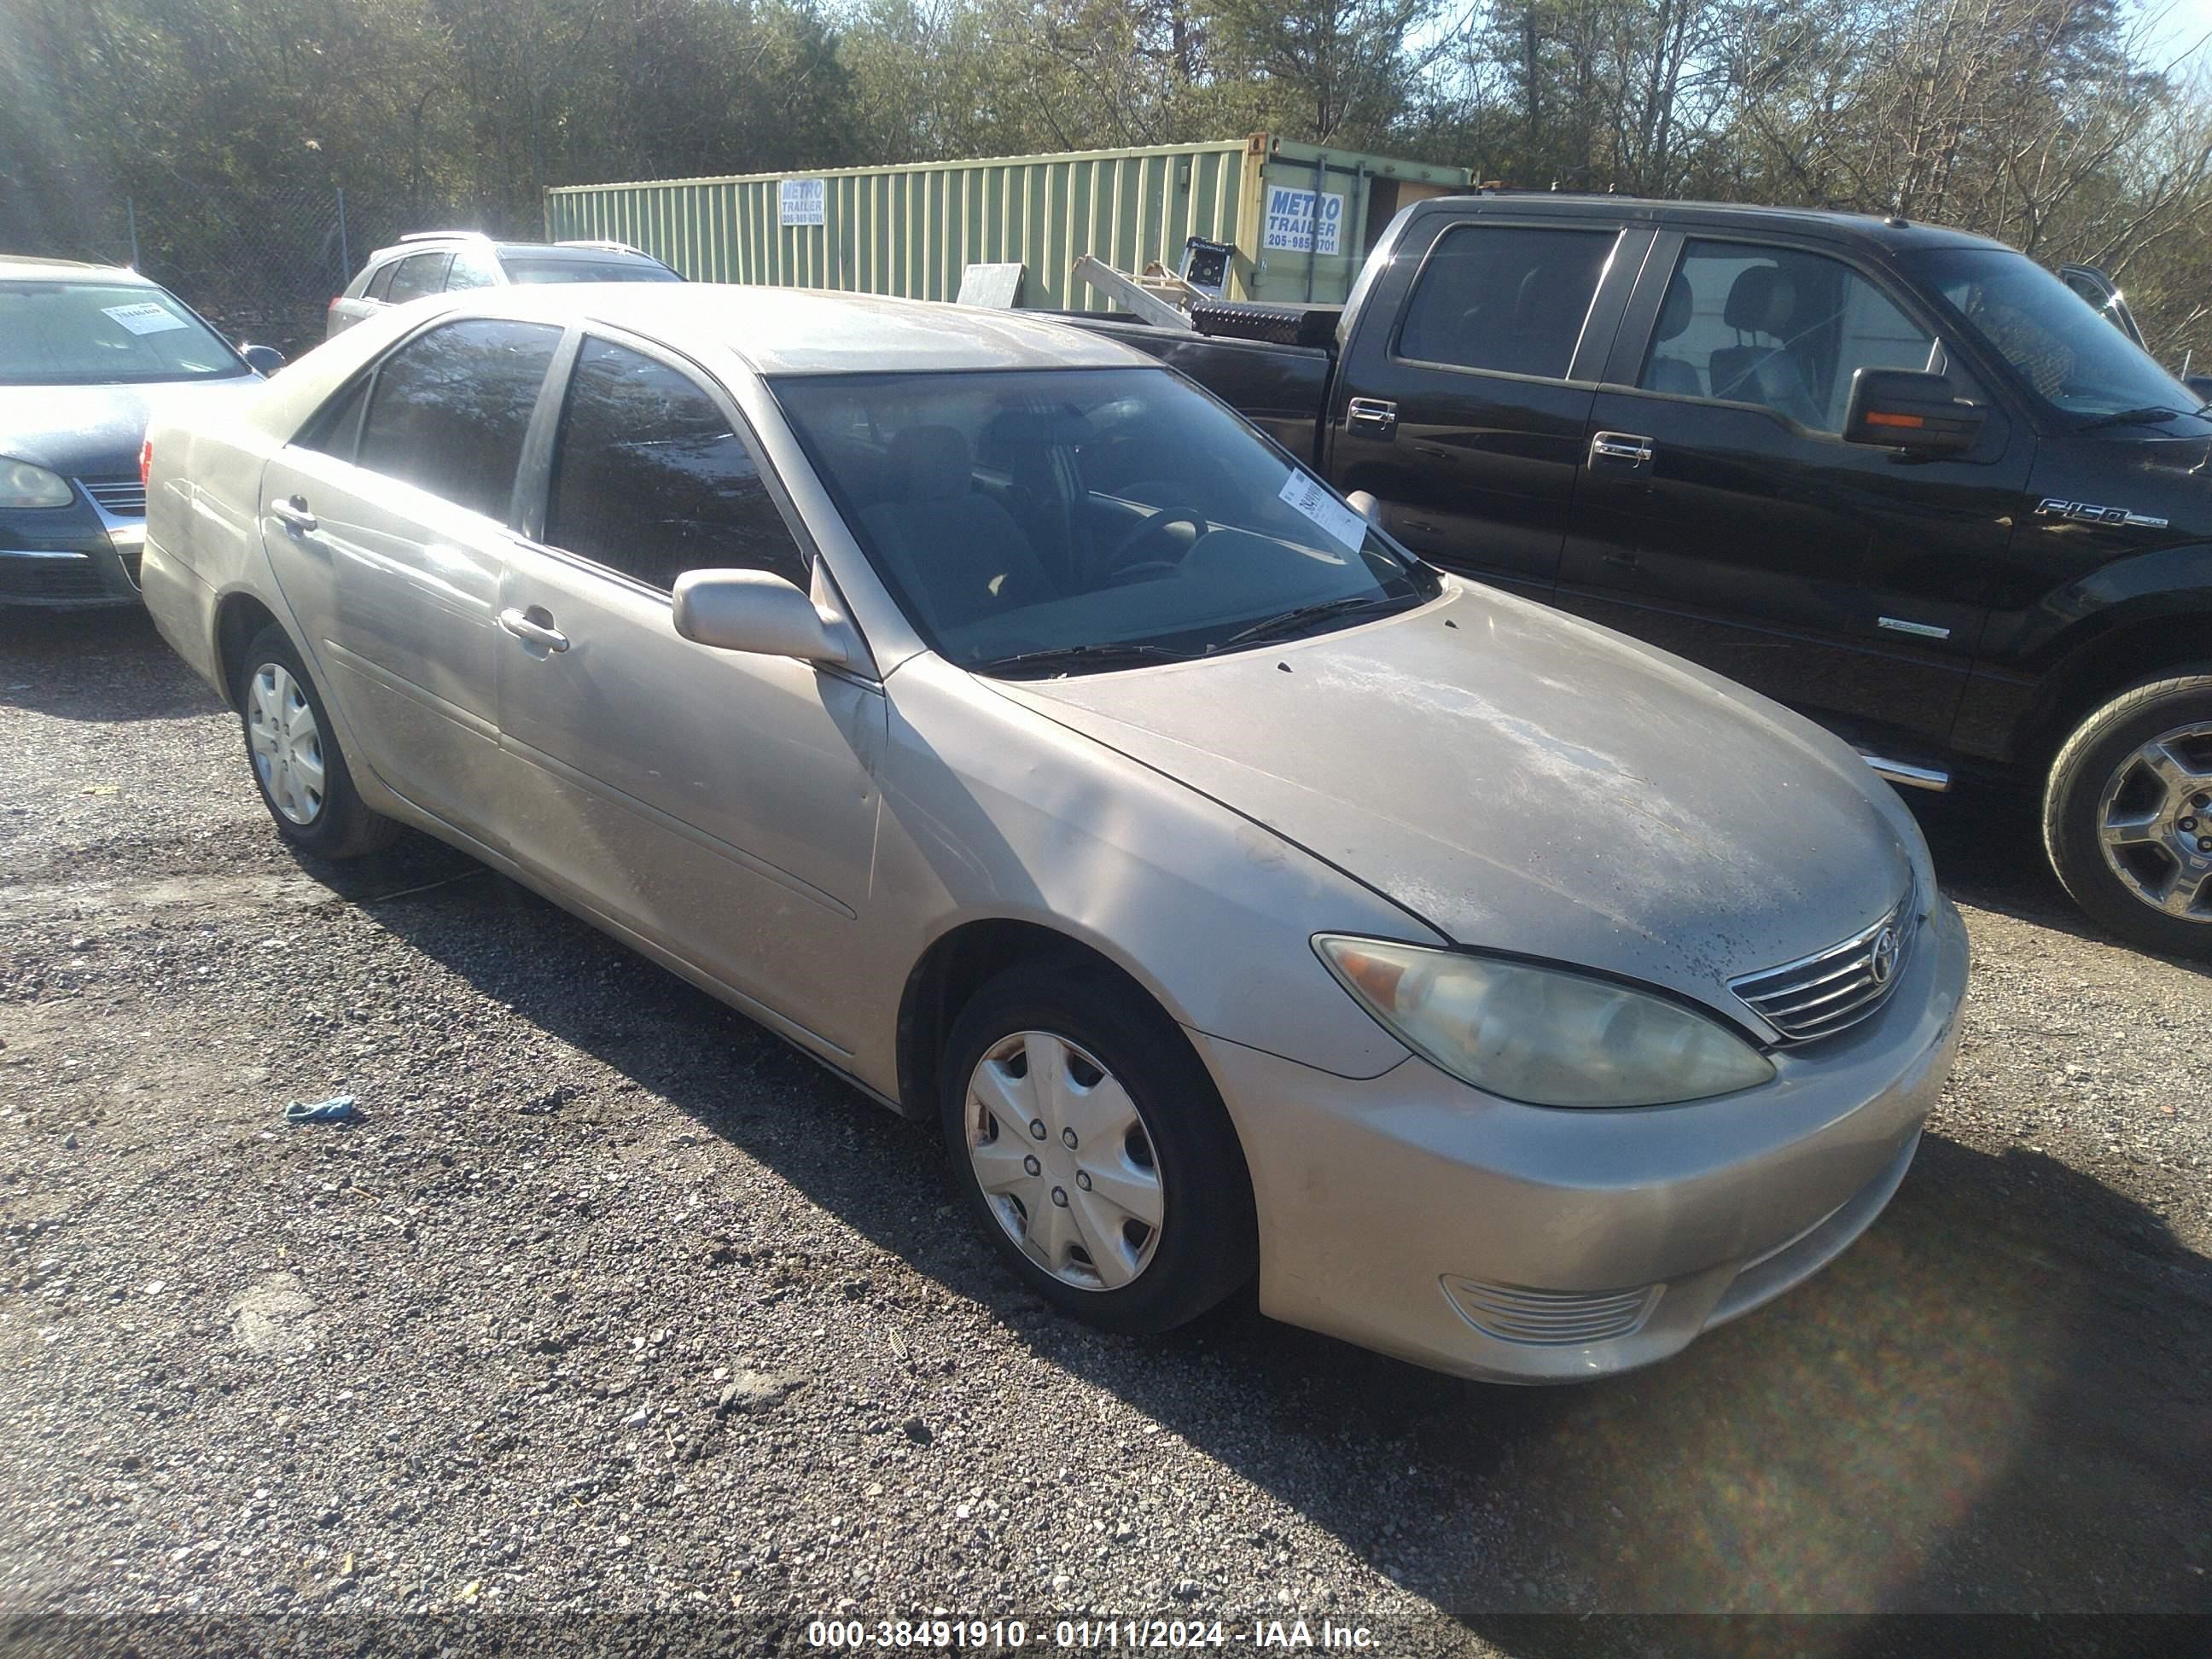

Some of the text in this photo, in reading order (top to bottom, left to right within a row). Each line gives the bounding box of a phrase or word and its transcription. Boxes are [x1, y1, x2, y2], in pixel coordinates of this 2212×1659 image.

[783, 180, 823, 200] METRO
[783, 201, 822, 212] TRAILER
[1271, 190, 1340, 220] METRO
[1270, 216, 1336, 237] TRAILER
